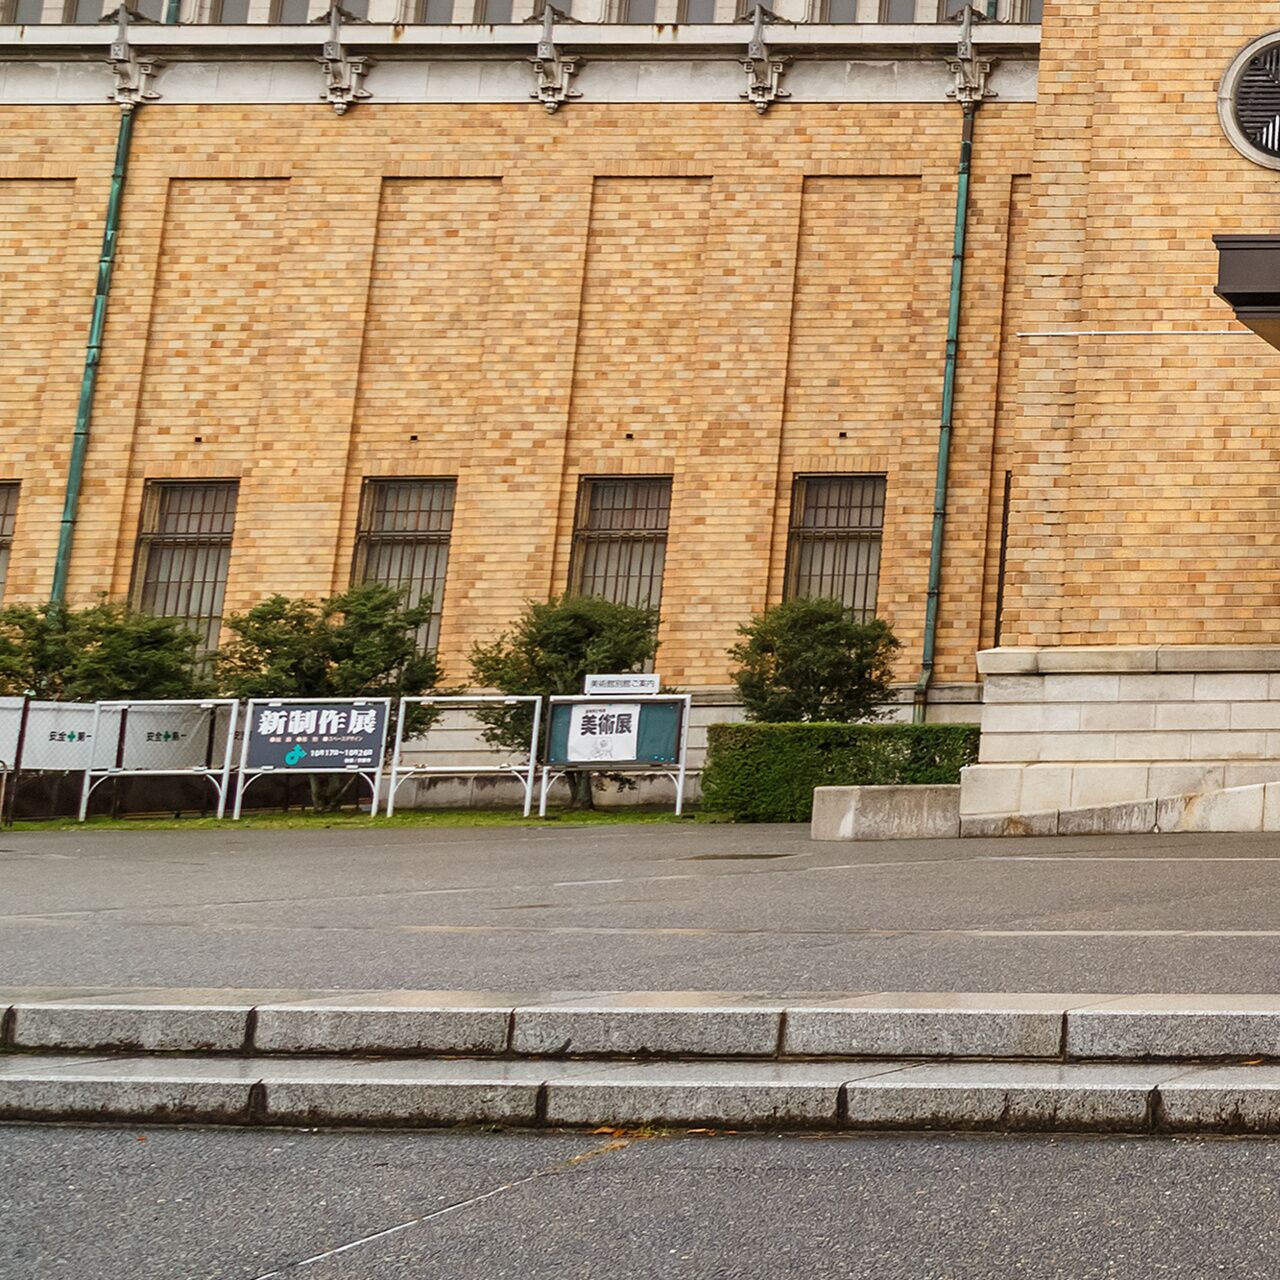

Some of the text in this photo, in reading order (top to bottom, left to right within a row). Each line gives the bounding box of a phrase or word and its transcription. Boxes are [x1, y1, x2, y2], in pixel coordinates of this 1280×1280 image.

[257, 709, 377, 735] 新制作展
[580, 713, 632, 736] 美術展
[49, 731, 92, 742] 安全 第一
[146, 731, 187, 742] 安全 第一
